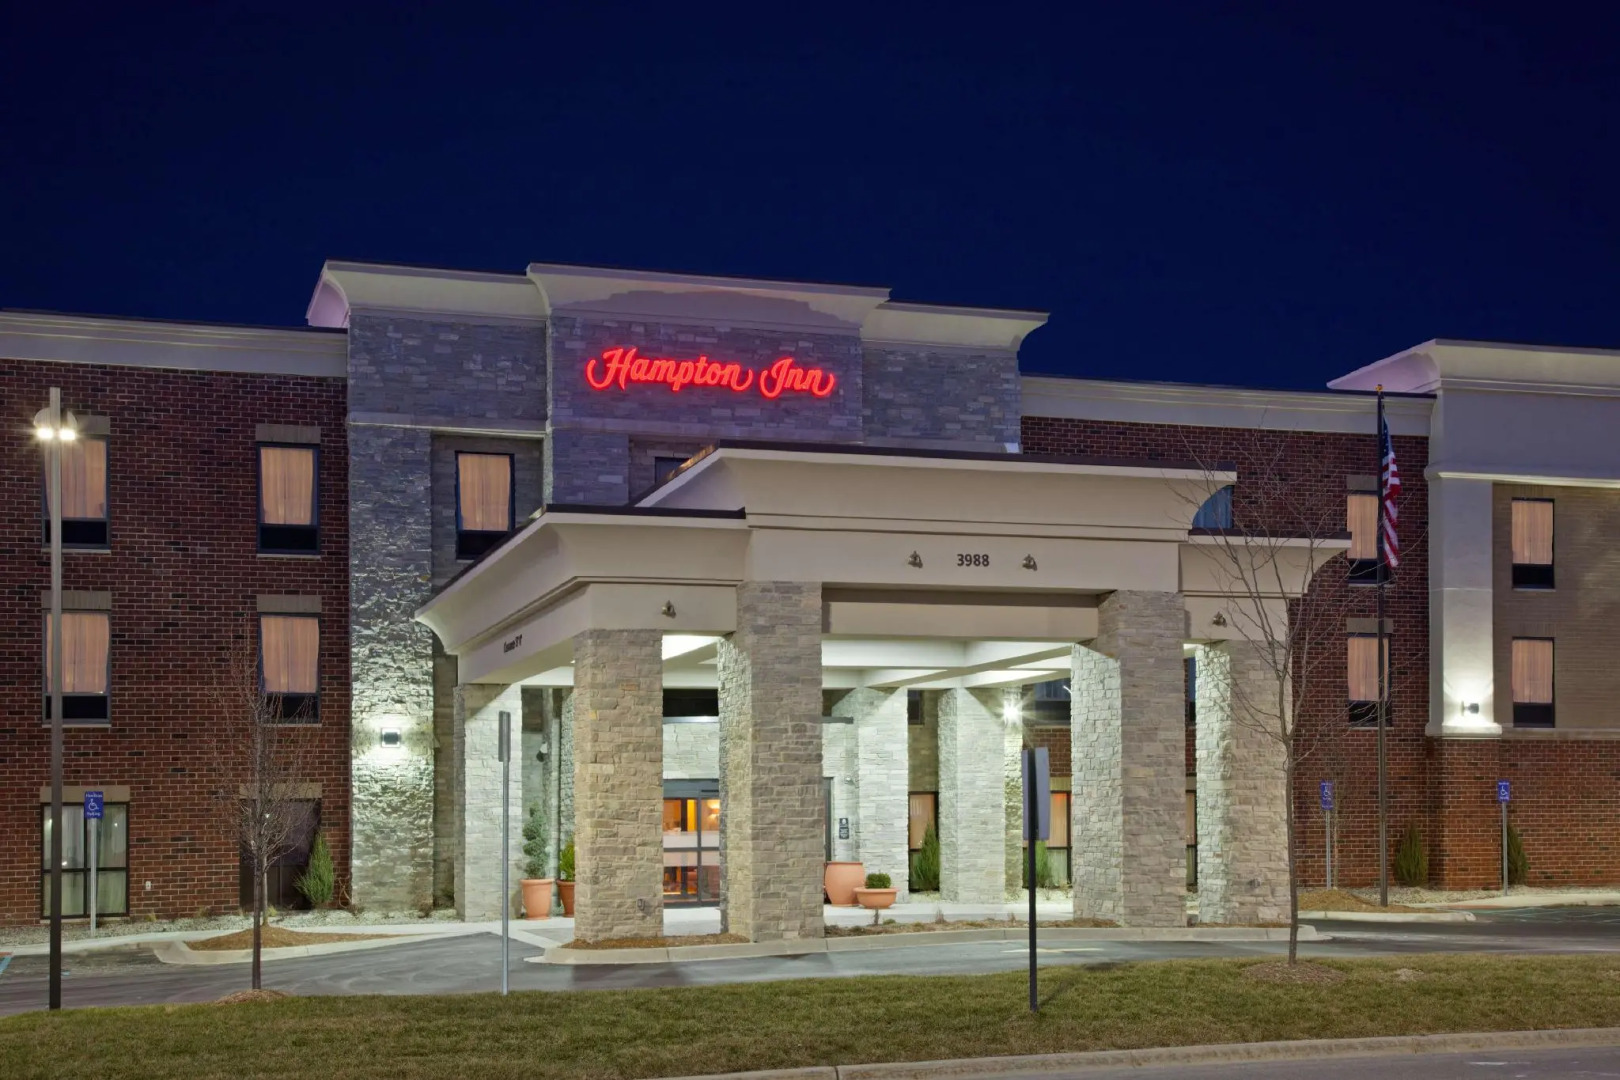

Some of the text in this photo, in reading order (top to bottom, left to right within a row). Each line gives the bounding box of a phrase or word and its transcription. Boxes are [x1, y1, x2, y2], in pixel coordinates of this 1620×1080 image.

[586, 348, 836, 398] Hampton Inn
[957, 553, 990, 567] 3988
